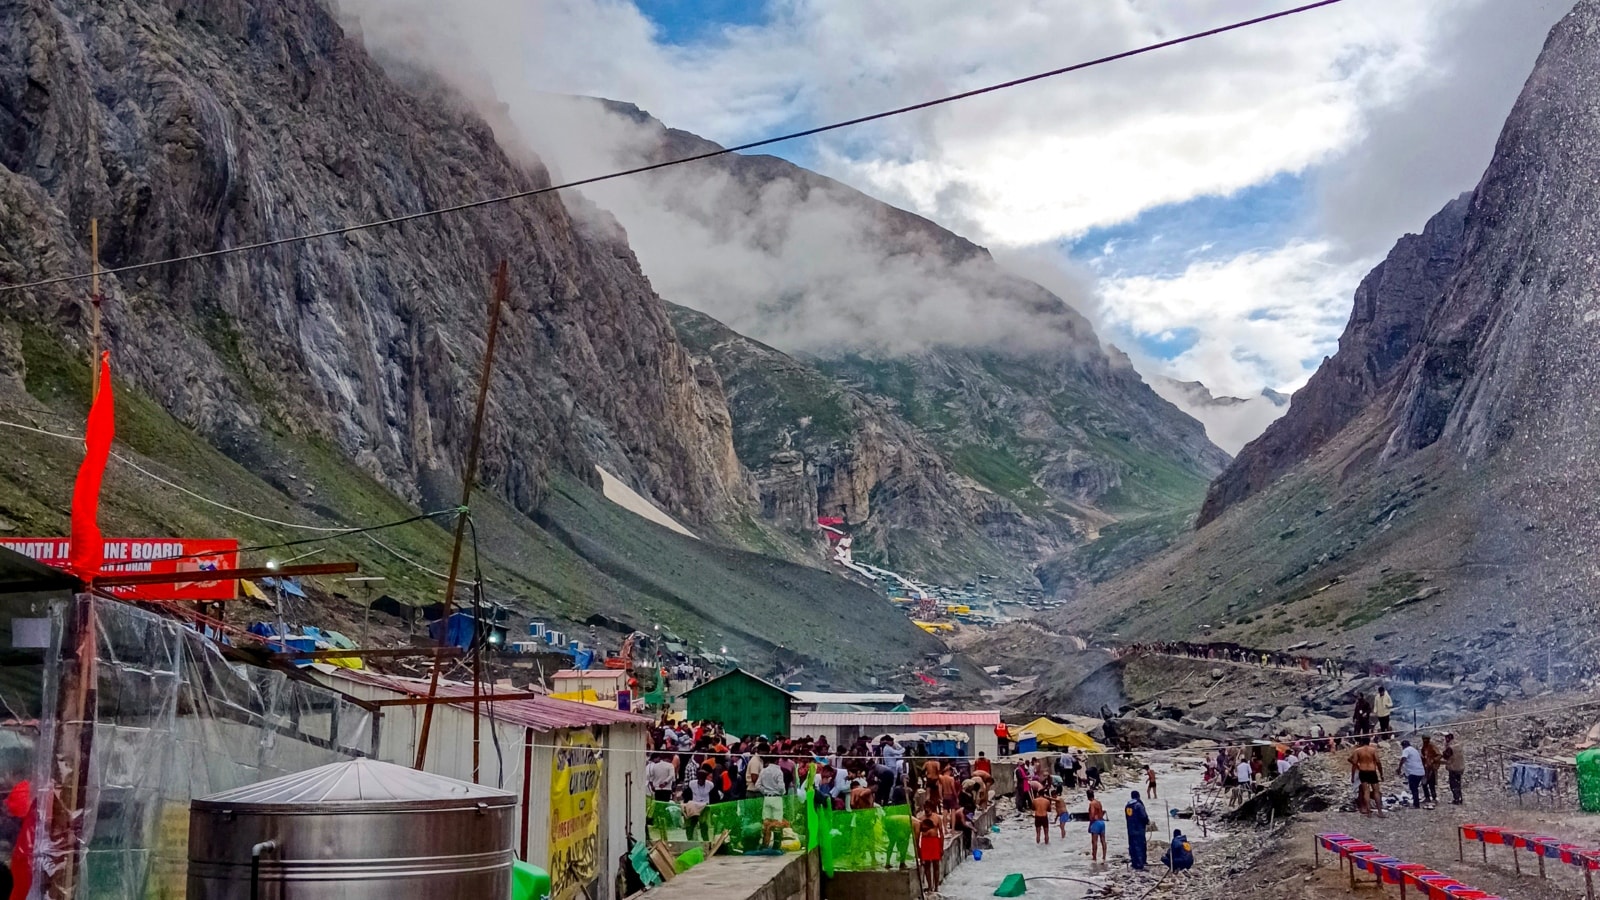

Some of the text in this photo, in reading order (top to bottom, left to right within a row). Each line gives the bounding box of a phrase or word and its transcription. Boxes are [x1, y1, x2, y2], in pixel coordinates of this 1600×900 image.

[103, 542, 129, 559] INE
[131, 542, 184, 559] BOARD
[125, 562, 152, 572] DHAM
